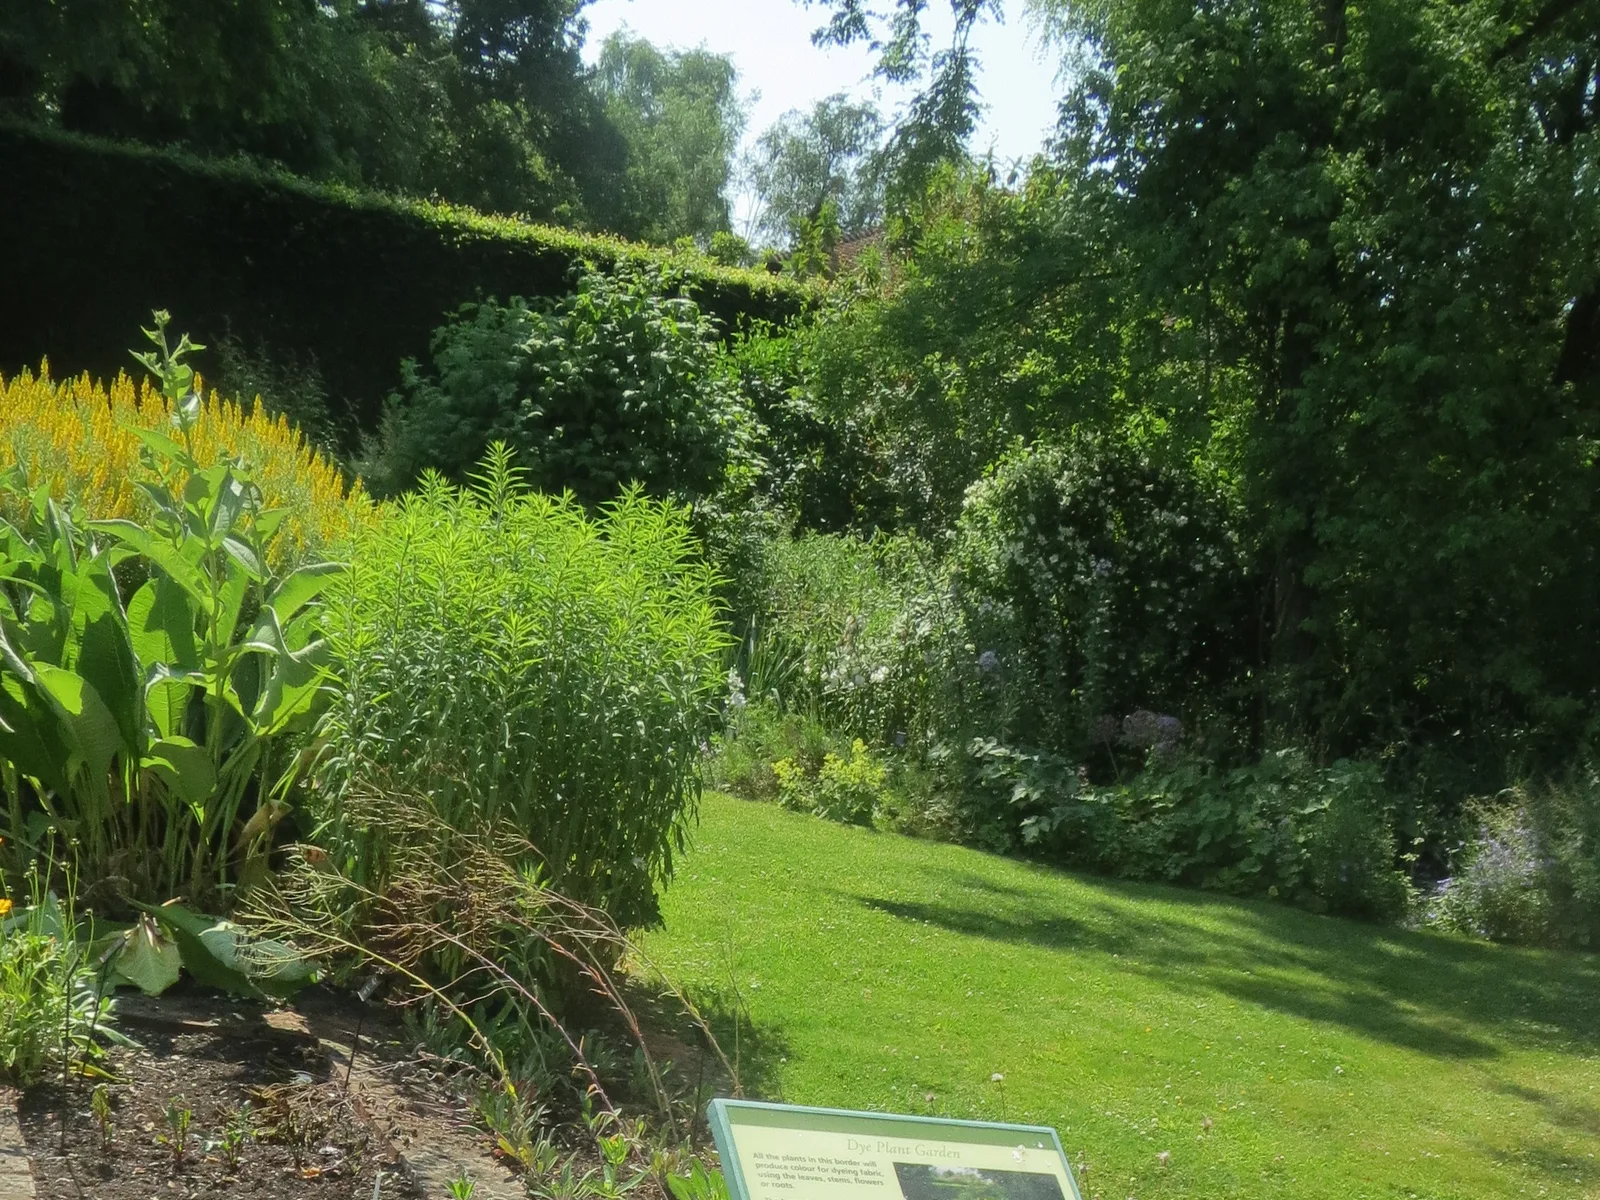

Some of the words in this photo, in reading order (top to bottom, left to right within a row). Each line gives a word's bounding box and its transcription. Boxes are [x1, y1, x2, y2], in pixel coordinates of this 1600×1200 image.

[848, 1139, 871, 1155] Dye
[877, 1141, 911, 1155] Plant
[915, 1144, 960, 1158] Garden
[835, 1158, 860, 1166] border
[756, 1162, 788, 1170] produce
[832, 1168, 858, 1176] dyeing
[860, 1169, 884, 1177] fabric,
[827, 1176, 852, 1184] stems,
[854, 1178, 884, 1186] flowers
